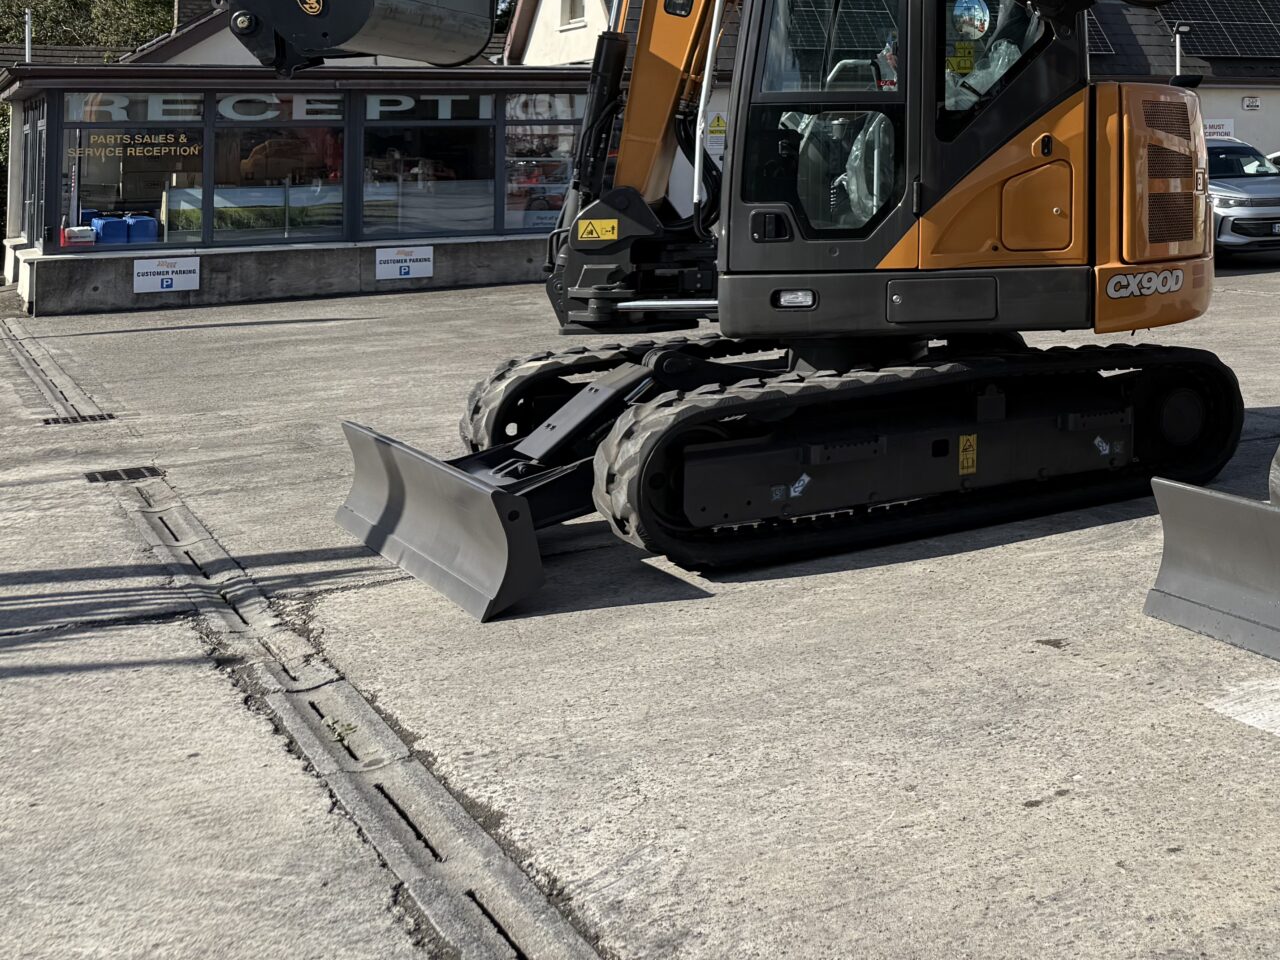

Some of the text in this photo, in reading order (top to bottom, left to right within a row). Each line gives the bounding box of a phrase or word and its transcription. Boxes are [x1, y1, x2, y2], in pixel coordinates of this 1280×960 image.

[179, 134, 187, 143] &
[67, 146, 199, 157] SERVICE RECEPTION
[136, 268, 197, 278] CUSTOMER PARKING
[1106, 269, 1184, 300] CX90D
